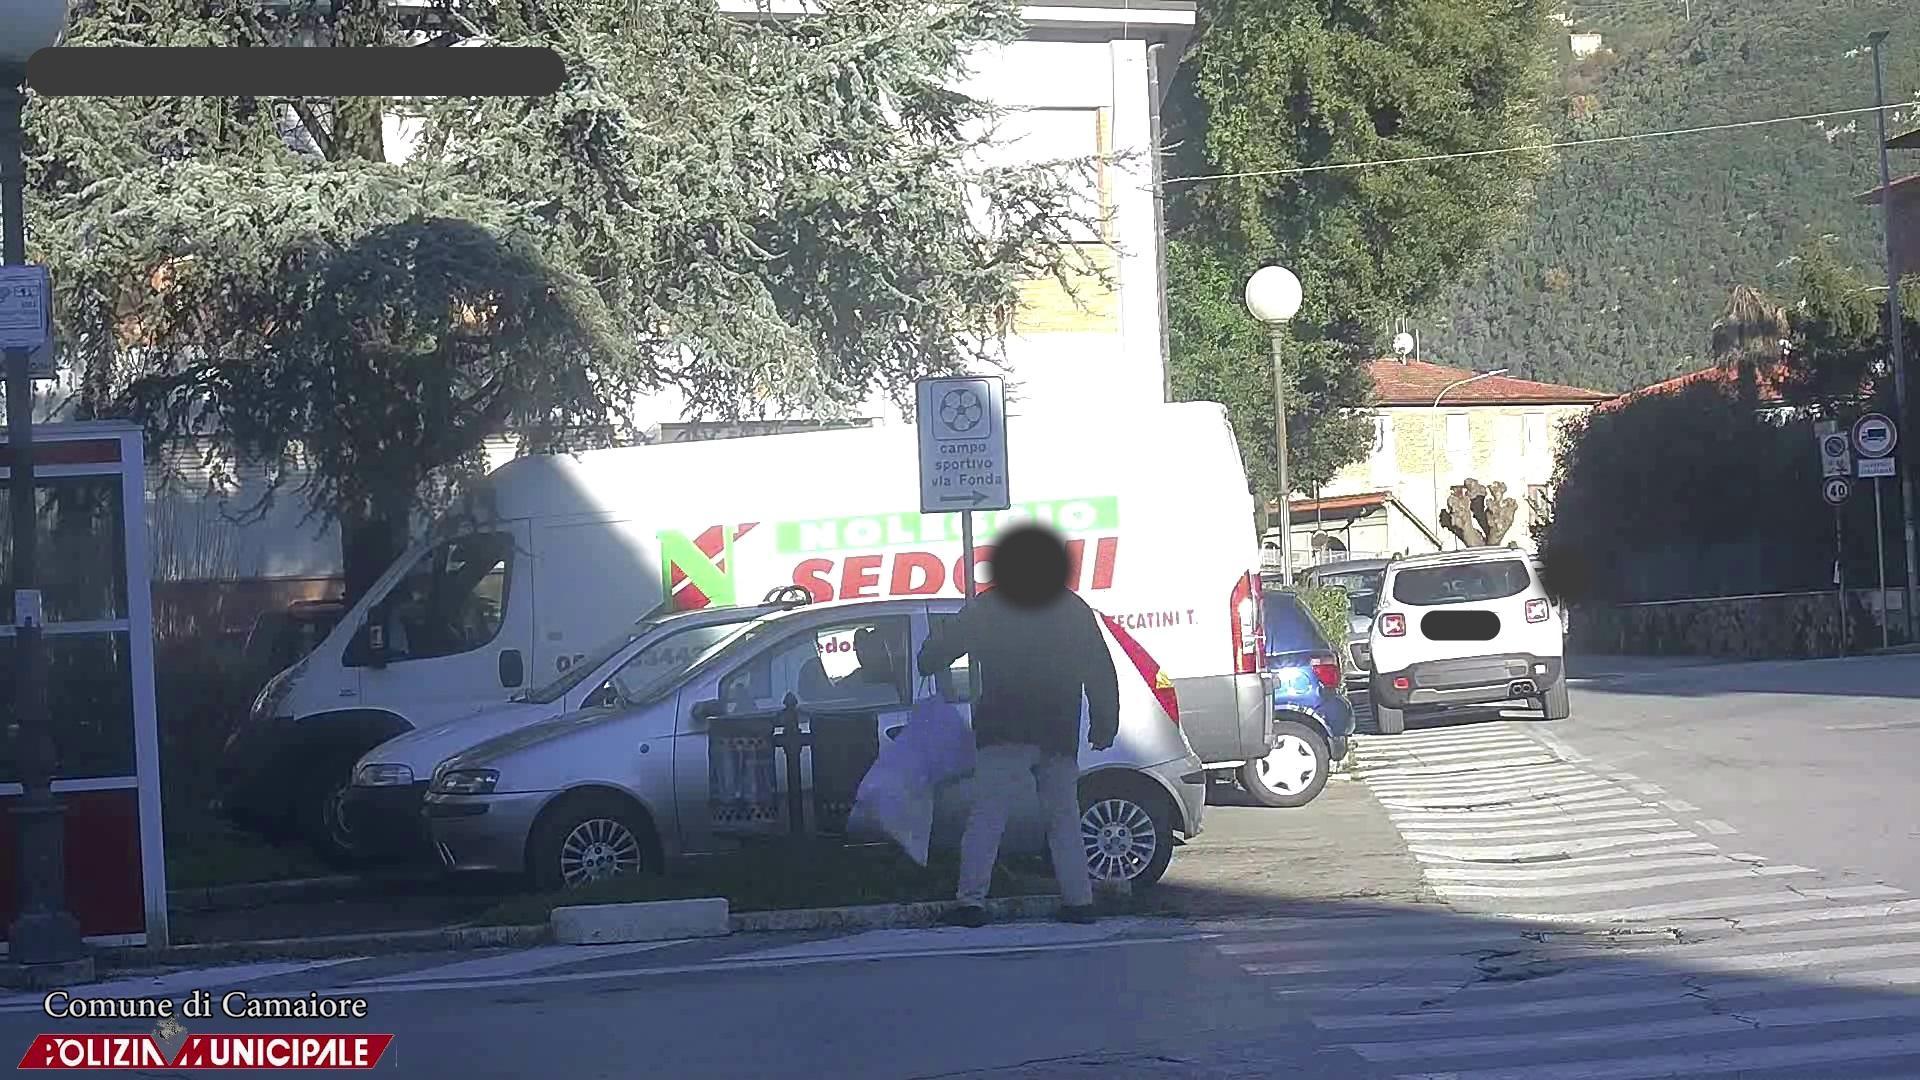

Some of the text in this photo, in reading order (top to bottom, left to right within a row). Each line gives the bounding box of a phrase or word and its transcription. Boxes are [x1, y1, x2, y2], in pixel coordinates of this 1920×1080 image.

[940, 442, 987, 455] campo
[935, 458, 993, 472] sportivo
[931, 473, 1002, 487] via Fonda
[1830, 484, 1846, 497] 40
[800, 500, 1100, 550] NOLEGGIO
[793, 537, 1119, 604] SEDOI
